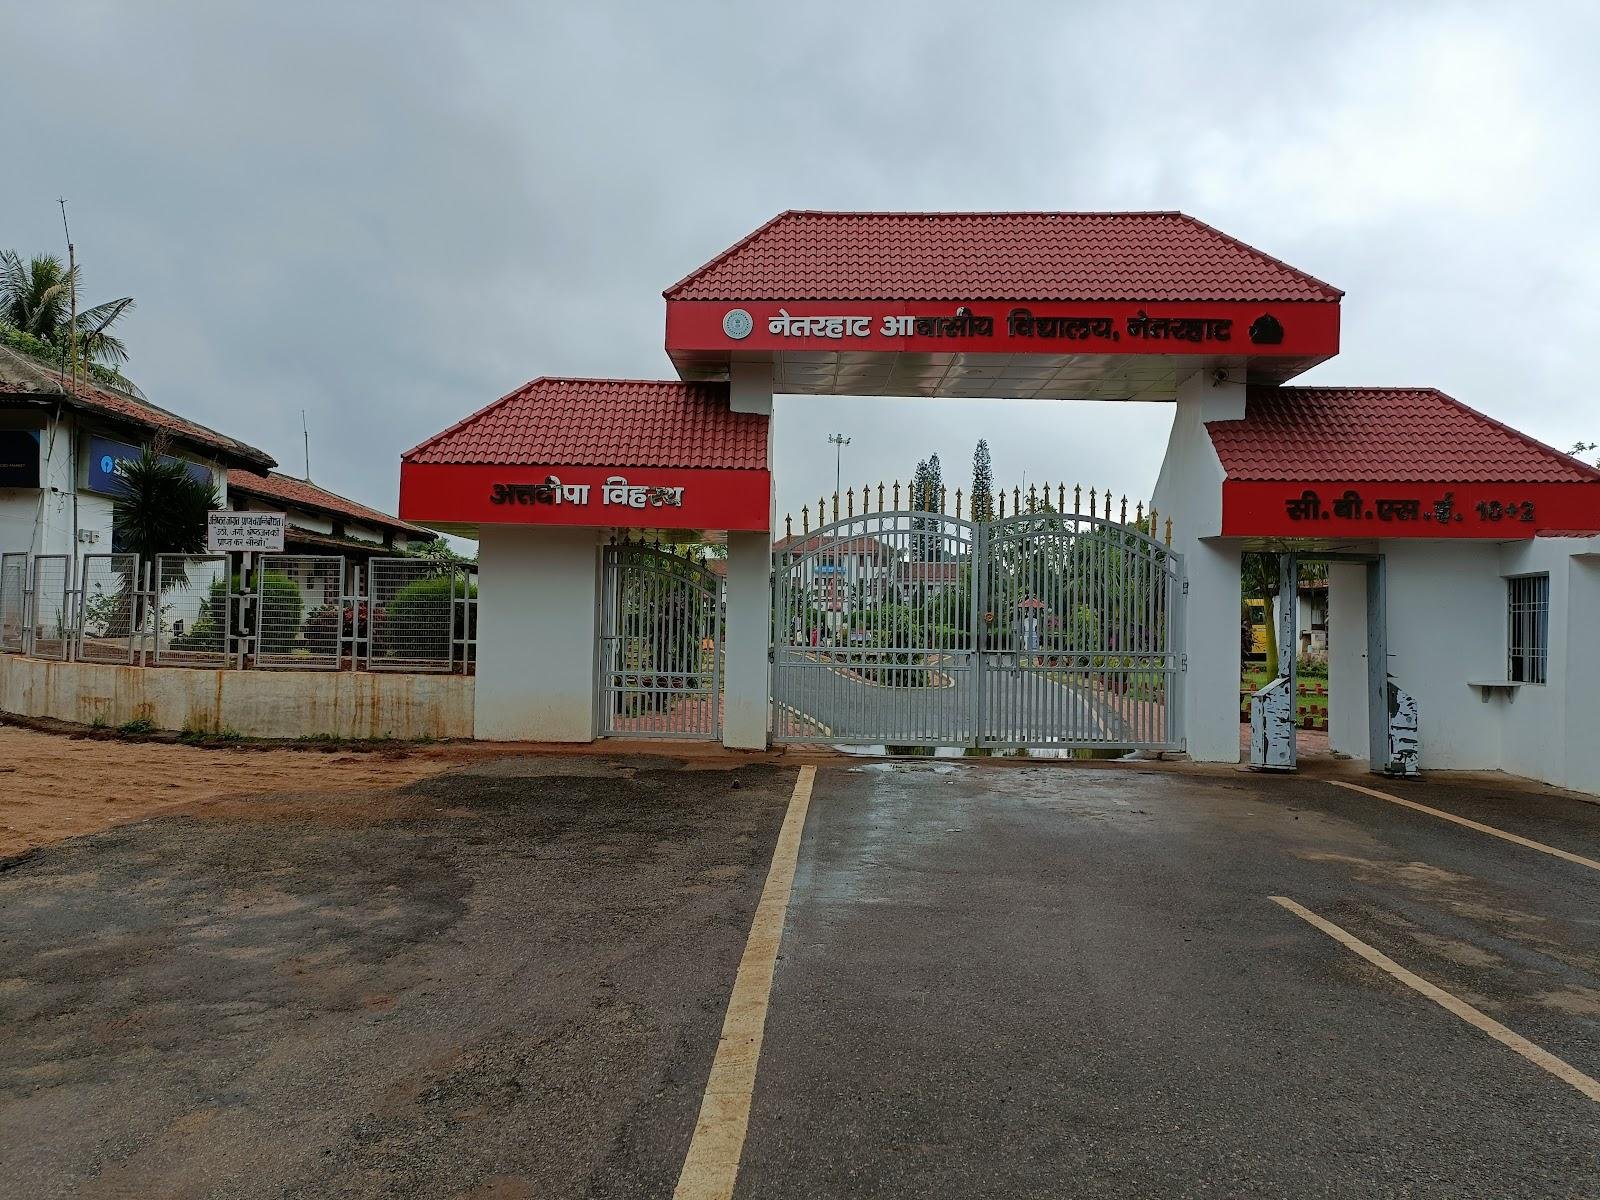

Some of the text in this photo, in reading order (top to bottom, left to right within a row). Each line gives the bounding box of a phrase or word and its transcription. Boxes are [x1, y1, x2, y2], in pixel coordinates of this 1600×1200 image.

[768, 308, 872, 338] नेतरहाट
[880, 306, 994, 338] आवासीय
[1126, 309, 1233, 342] नेतरहाट
[1475, 500, 1536, 523] 10+2
